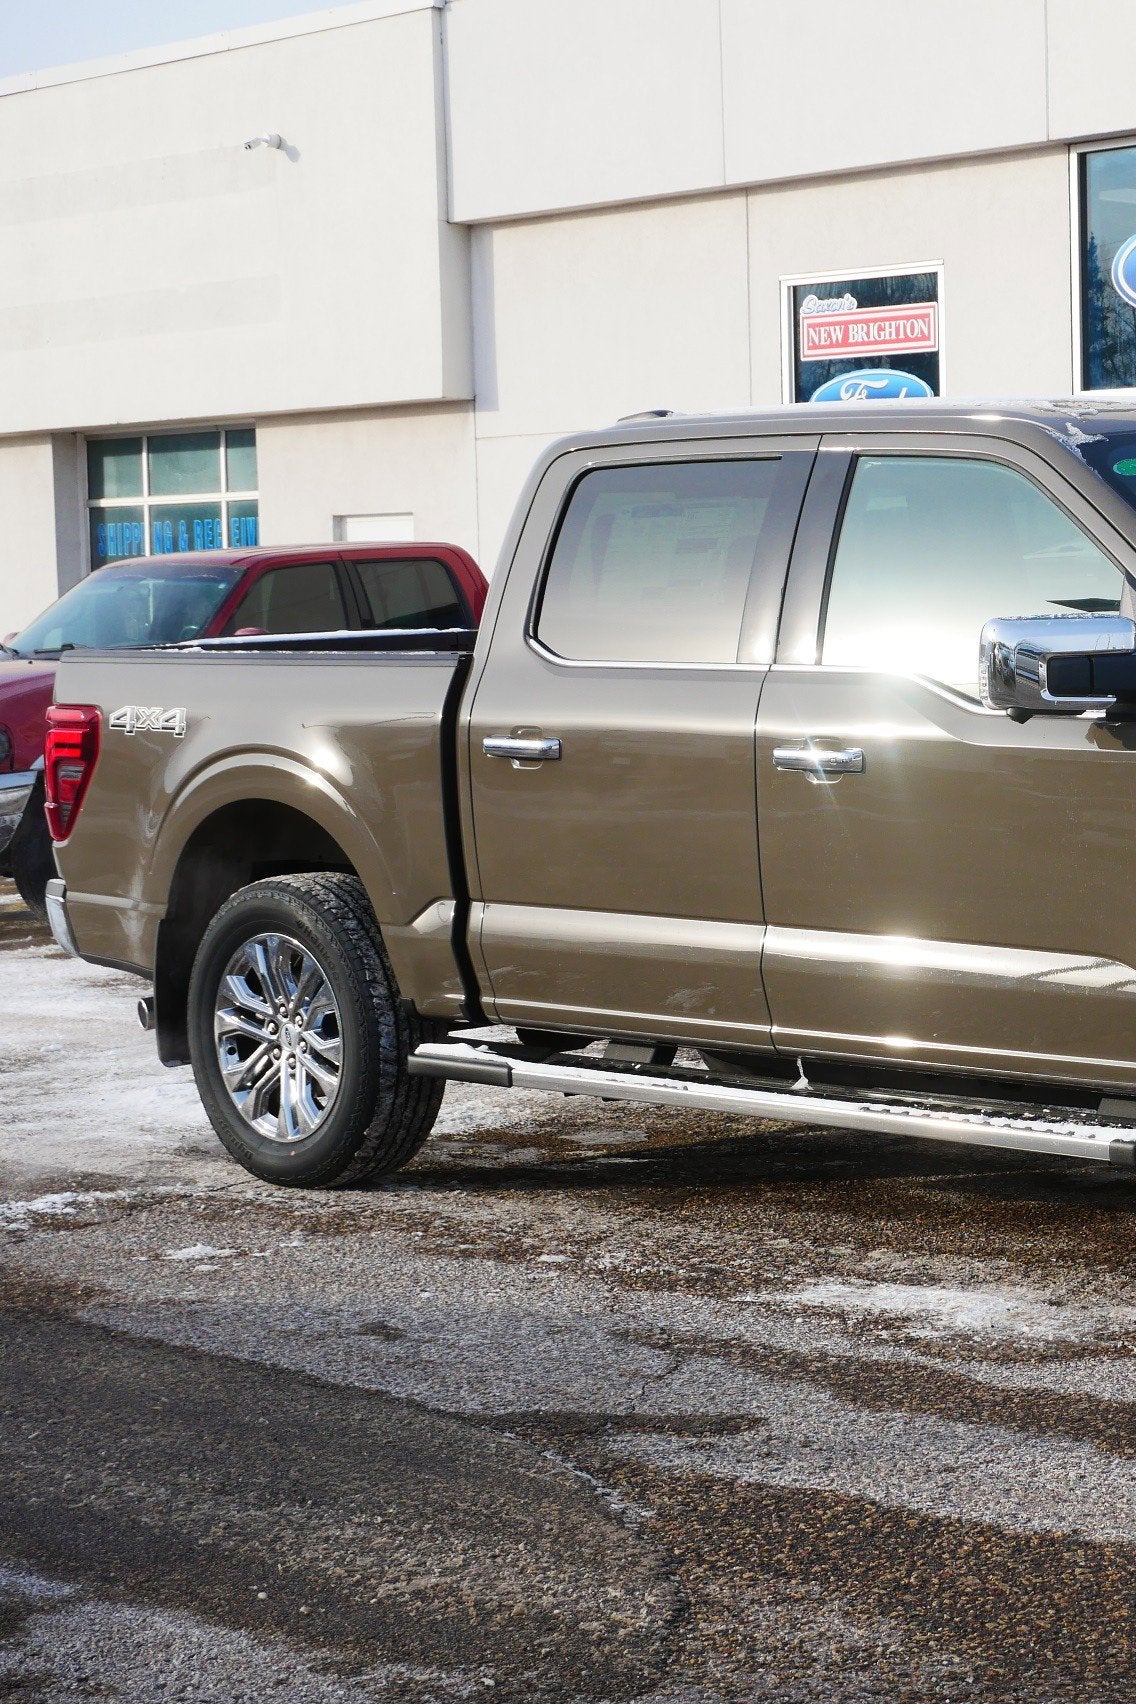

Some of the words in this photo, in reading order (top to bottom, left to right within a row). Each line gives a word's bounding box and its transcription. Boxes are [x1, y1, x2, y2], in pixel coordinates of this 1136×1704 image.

[808, 325, 845, 347] NEW
[848, 317, 930, 343] BRIGHTON
[178, 519, 189, 553] &
[193, 516, 259, 552] RECEIV
